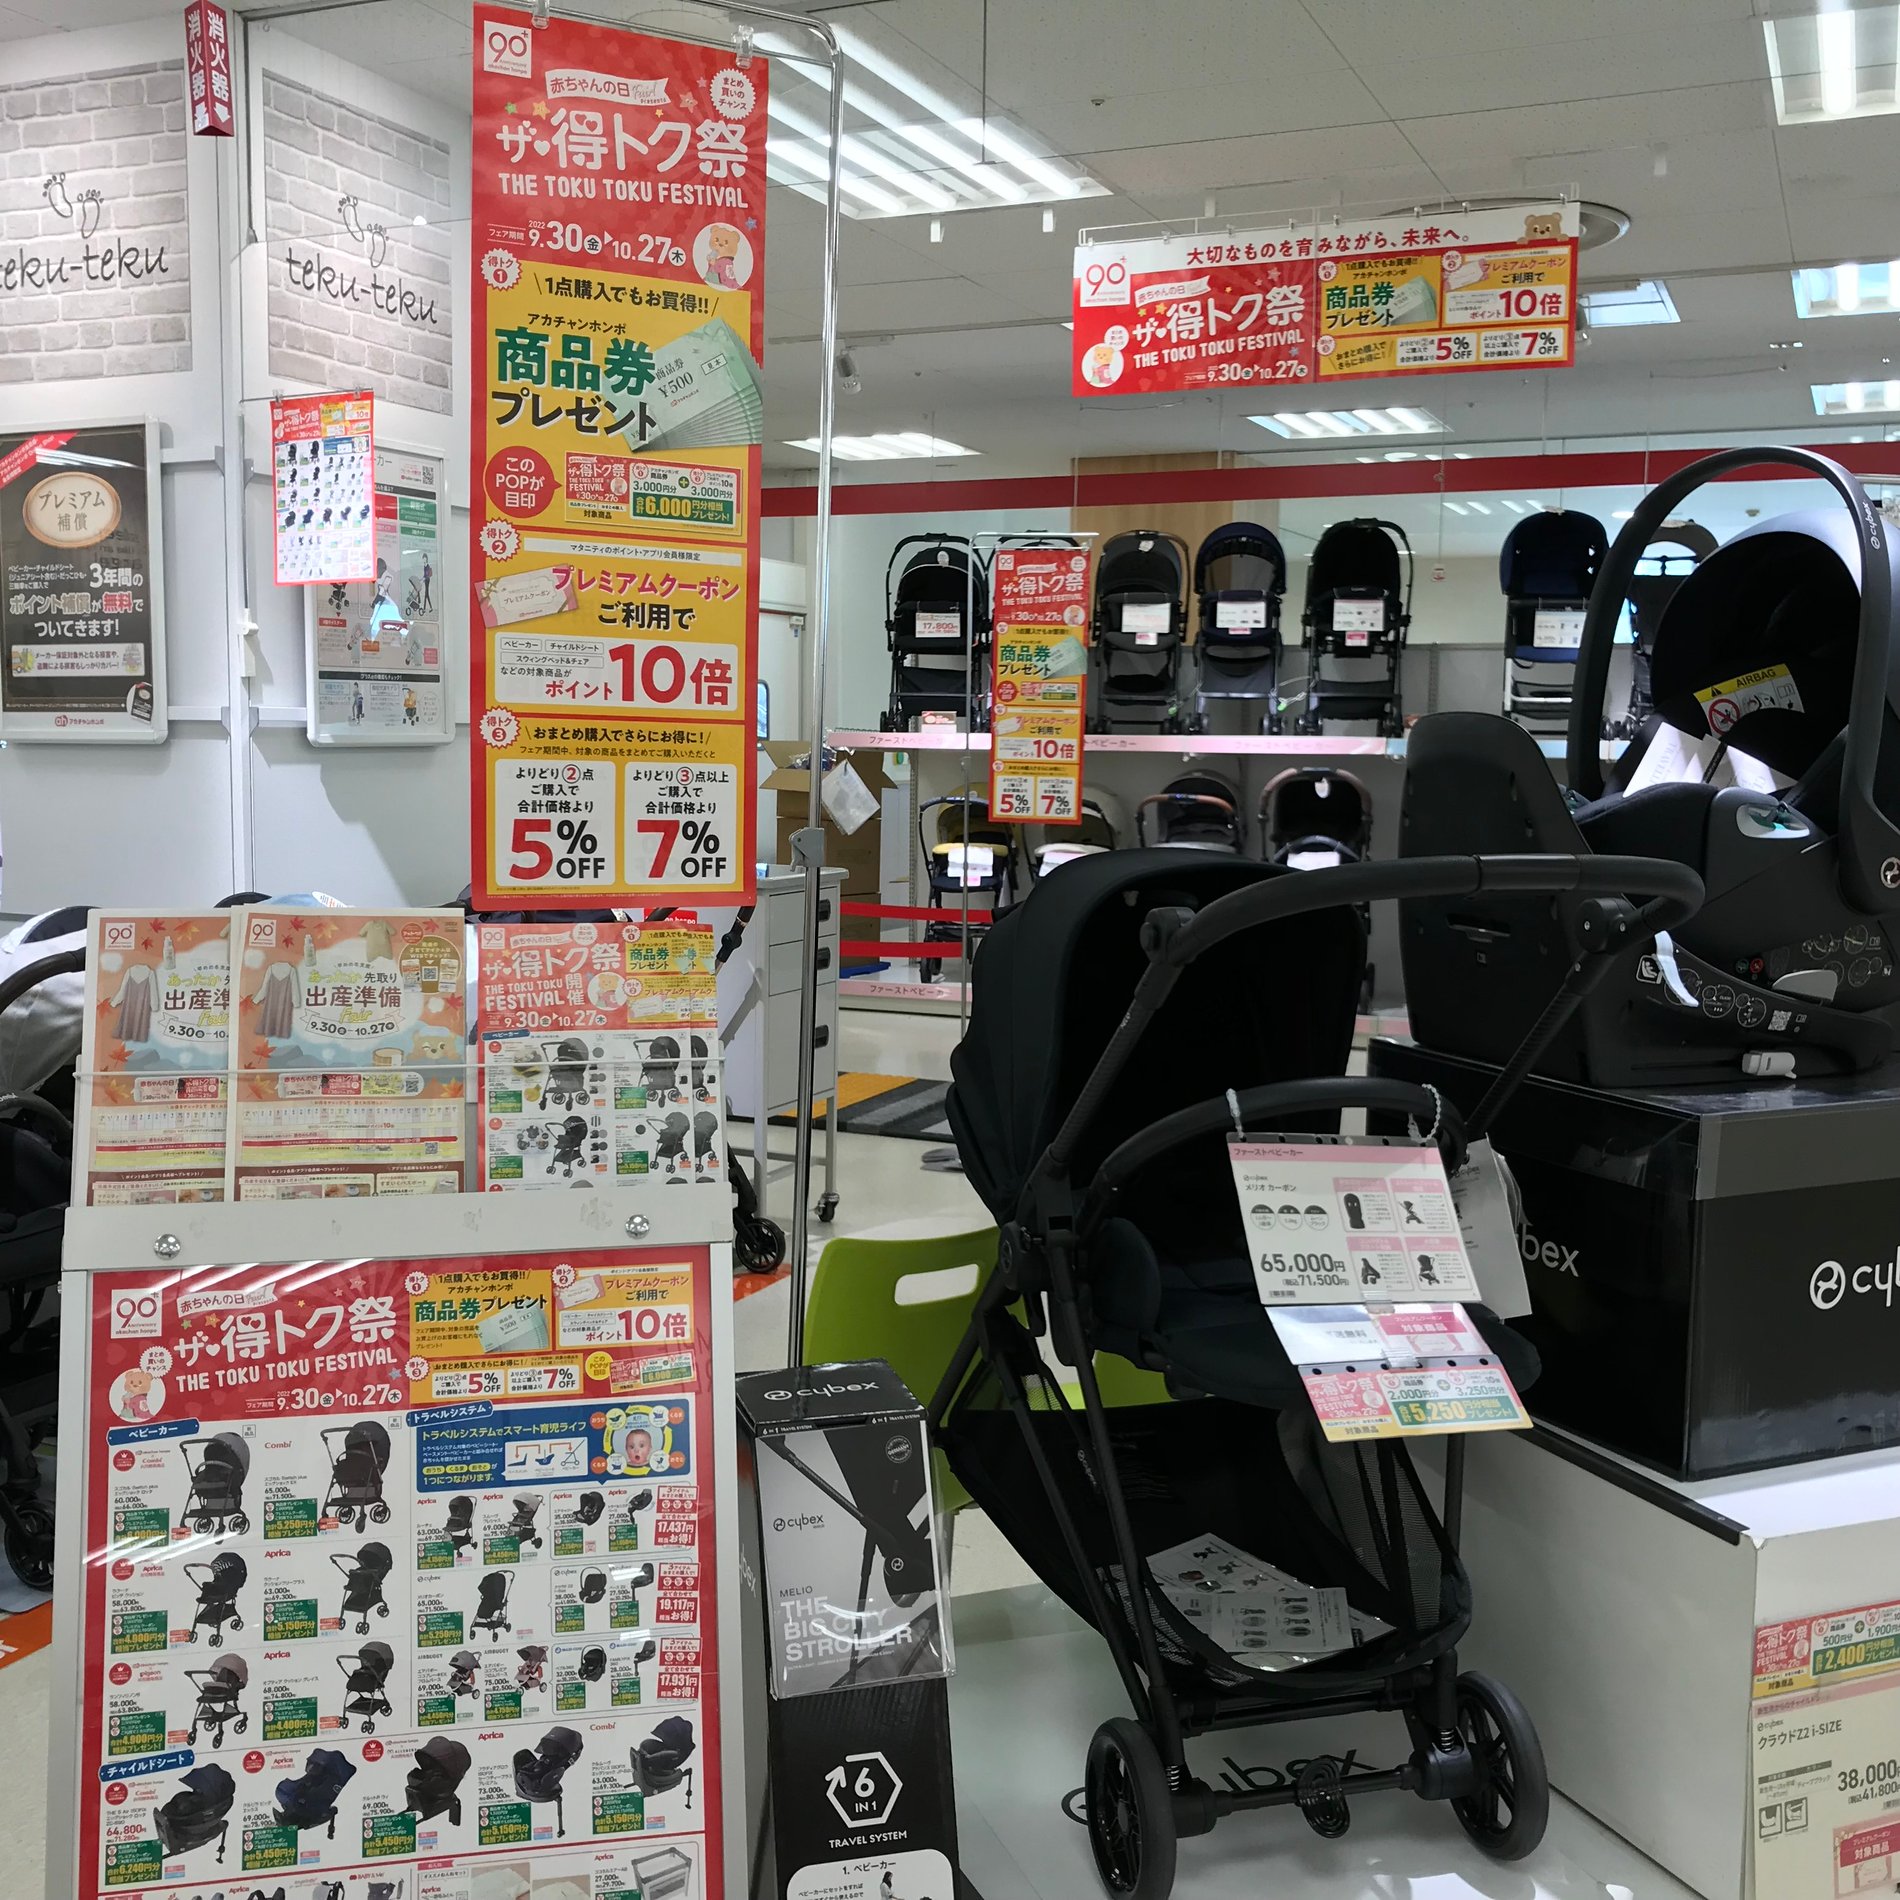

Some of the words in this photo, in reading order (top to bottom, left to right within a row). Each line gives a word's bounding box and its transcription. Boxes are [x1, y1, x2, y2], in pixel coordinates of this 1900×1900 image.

[207, 9, 229, 102] 消火器
[550, 78, 630, 96] 赤ちゃんの日
[722, 77, 744, 88] まとめ
[719, 99, 747, 110] チャンス
[499, 173, 537, 195] THE
[545, 176, 595, 199] TOKU
[603, 179, 652, 202] TOKU
[658, 183, 748, 208] FESTIVAL
[488, 256, 514, 268] 得トク
[286, 248, 438, 324] teku-teku
[1501, 272, 1544, 284] ご利用で
[1326, 281, 1395, 310] 商品券
[1326, 306, 1394, 329] プレゼント
[1470, 309, 1502, 319] ポイント
[528, 312, 626, 335] アカチャンホンポ
[1134, 353, 1159, 368] THE
[1163, 346, 1196, 363] TOKU
[1201, 341, 1234, 357] TOKU
[1238, 329, 1304, 352] FESTIVAL
[495, 326, 656, 396] 商品券
[492, 387, 656, 441] プレゼント
[506, 457, 535, 471] この
[495, 475, 545, 490] POPが
[39, 491, 106, 510] プレミアム
[505, 493, 535, 508] 目印
[645, 496, 692, 518] 6,000
[57, 512, 88, 532] 補償
[1863, 502, 1877, 535] cybex
[486, 527, 512, 539] 得トク
[90, 563, 143, 588] 3年間の
[552, 564, 739, 601] プレミアムクーポン
[598, 602, 696, 630] ご利用で
[35, 620, 120, 636] ついてきます!
[504, 640, 539, 649] ベビーカー
[549, 642, 599, 652] チャイルドシート
[1001, 645, 1051, 663] 商品券
[501, 667, 571, 678] などの対象商品が
[1736, 669, 1776, 687] AIRBAG
[545, 680, 613, 701] ポイント
[486, 716, 512, 727] 得トク
[533, 726, 704, 744] おまとめ購入でさらにお得に!
[531, 783, 579, 797] ご購入で
[658, 785, 703, 799] ご購入で
[518, 799, 594, 814] 合計価格より
[646, 802, 717, 815] 合計価格より
[556, 858, 605, 879] OFF
[681, 858, 727, 878] OFF
[630, 948, 669, 961] 商品券
[364, 972, 397, 984] 先取り
[485, 984, 504, 996] THE
[508, 981, 533, 993] TOKU
[536, 979, 563, 991] TOKU
[306, 986, 402, 1008] 出産準備
[485, 992, 565, 1011] FESTIVAL
[1234, 1147, 1303, 1157] ファーストベビーカー
[1245, 1183, 1265, 1191] メリオ
[1260, 1253, 1346, 1273] 65,000円
[606, 1276, 689, 1289] プレミアムクーポン
[1852, 1245, 1900, 1307] cy
[448, 1284, 513, 1294] アカチャンホンポ
[626, 1290, 669, 1301] ご利用で
[180, 1294, 245, 1313] 赤ちゃんの日
[414, 1298, 481, 1322] 商品券
[482, 1295, 548, 1311] プレゼント
[586, 1330, 623, 1341] ポイント
[176, 1374, 210, 1392] THE
[215, 1366, 260, 1386] TOKU
[266, 1360, 309, 1380] TOKU
[316, 1348, 397, 1373] FESTIVAL
[559, 1380, 576, 1388] OFF
[797, 1380, 880, 1399] cybex
[413, 1405, 486, 1423] トラベルシステム
[128, 1425, 178, 1439] ベビーカー
[264, 1440, 292, 1450] Combi
[787, 1514, 824, 1531] cybex
[264, 1549, 291, 1558] Aprica
[780, 1586, 813, 1598] MELIO
[780, 1596, 828, 1618] THE
[784, 1618, 825, 1640] BIG
[786, 1625, 912, 1662] STROLLER
[264, 1650, 291, 1660] Aprica
[478, 1731, 504, 1740] Aprica
[590, 1722, 616, 1731] Combi
[1758, 1728, 1809, 1750] クラウドZ2
[1812, 1720, 1842, 1736] i-SIZE
[107, 1755, 186, 1778] チャイルドシート
[855, 1767, 875, 1798] 6
[855, 1802, 869, 1813] IN
[871, 1801, 877, 1811] 1
[829, 1837, 867, 1849] TRAVEL
[869, 1830, 907, 1843] SYSTEM
[854, 1860, 897, 1872] ベビーカー
